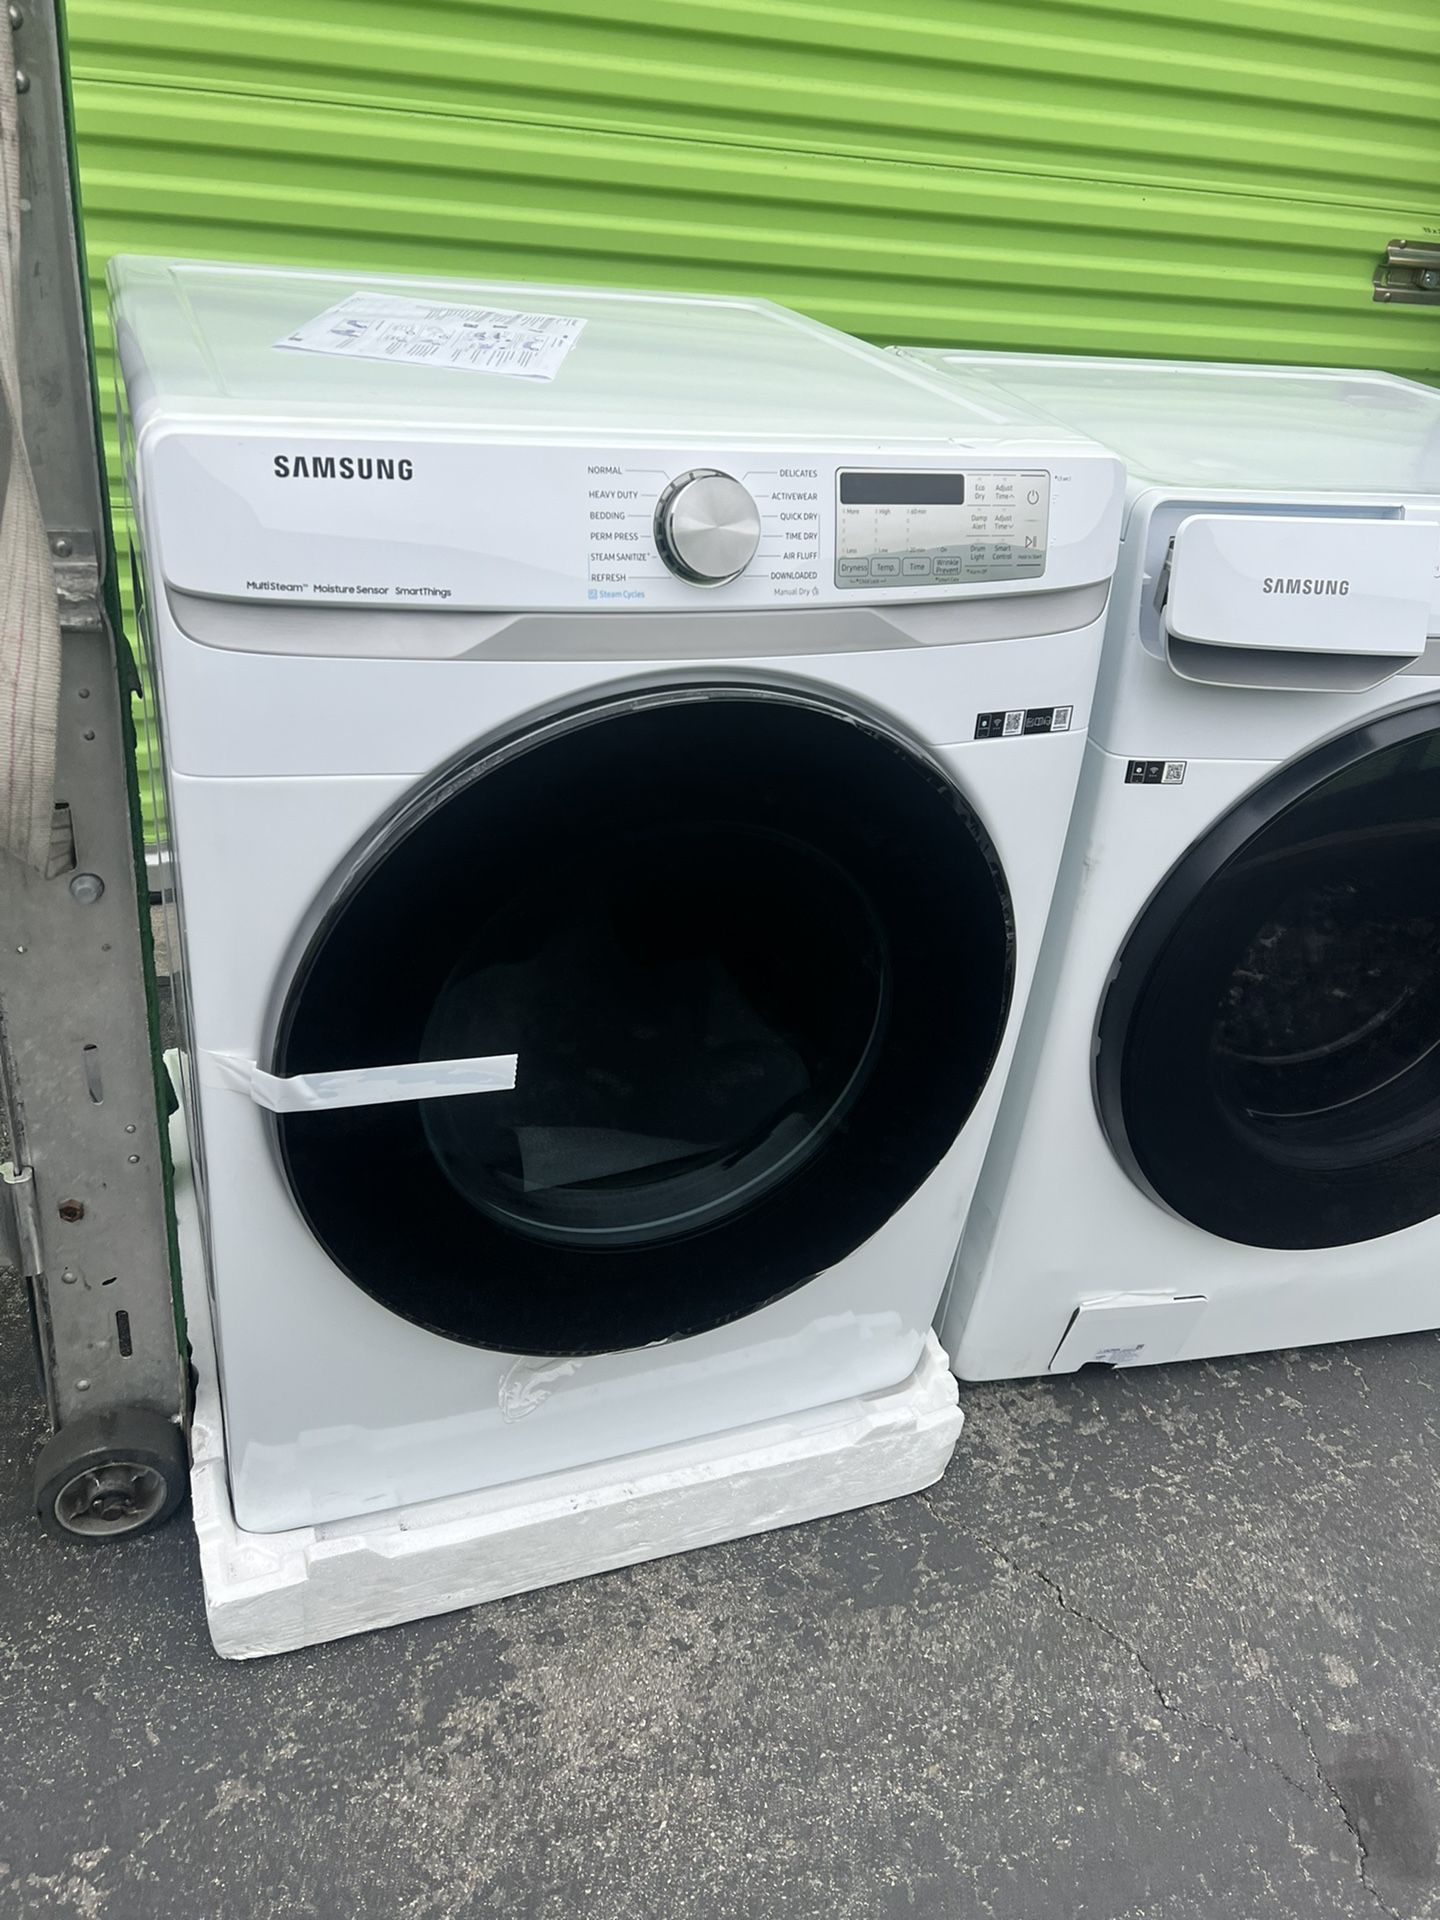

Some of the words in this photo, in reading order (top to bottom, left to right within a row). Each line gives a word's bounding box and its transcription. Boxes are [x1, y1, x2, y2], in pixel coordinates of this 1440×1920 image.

[274, 455, 413, 480] SAMSUNG
[587, 465, 622, 475] NORMAL
[779, 468, 818, 478] DELICATES
[995, 484, 1013, 492] Adjust
[589, 490, 615, 499] HEAVY
[617, 490, 638, 499] DUTY
[771, 491, 818, 501] ACTIVEWEAR
[589, 511, 625, 520] BEDDING
[780, 512, 801, 521] QUICK
[803, 512, 818, 521] DRY
[994, 514, 1012, 522] Adjust
[590, 532, 613, 541] PERM
[614, 532, 639, 541] PRESS
[785, 532, 801, 541] TIME
[803, 532, 818, 541] DRY
[590, 553, 615, 561] STEAM
[783, 552, 795, 560] AIR
[797, 552, 818, 560] FLUFF
[841, 564, 868, 573] Dryness
[910, 562, 925, 571] Time
[936, 567, 959, 575] Prevent
[591, 573, 626, 582] REFRESH
[771, 572, 818, 580] DOWNLOADED
[1263, 577, 1349, 595] SAMSUNG
[313, 584, 355, 594] Moisture
[356, 585, 389, 595] Sensor
[395, 586, 451, 599] SmartThings
[599, 590, 622, 598] Steam
[623, 590, 645, 599] Cycles
[774, 587, 798, 596] Manual
[799, 587, 811, 597] Dry
